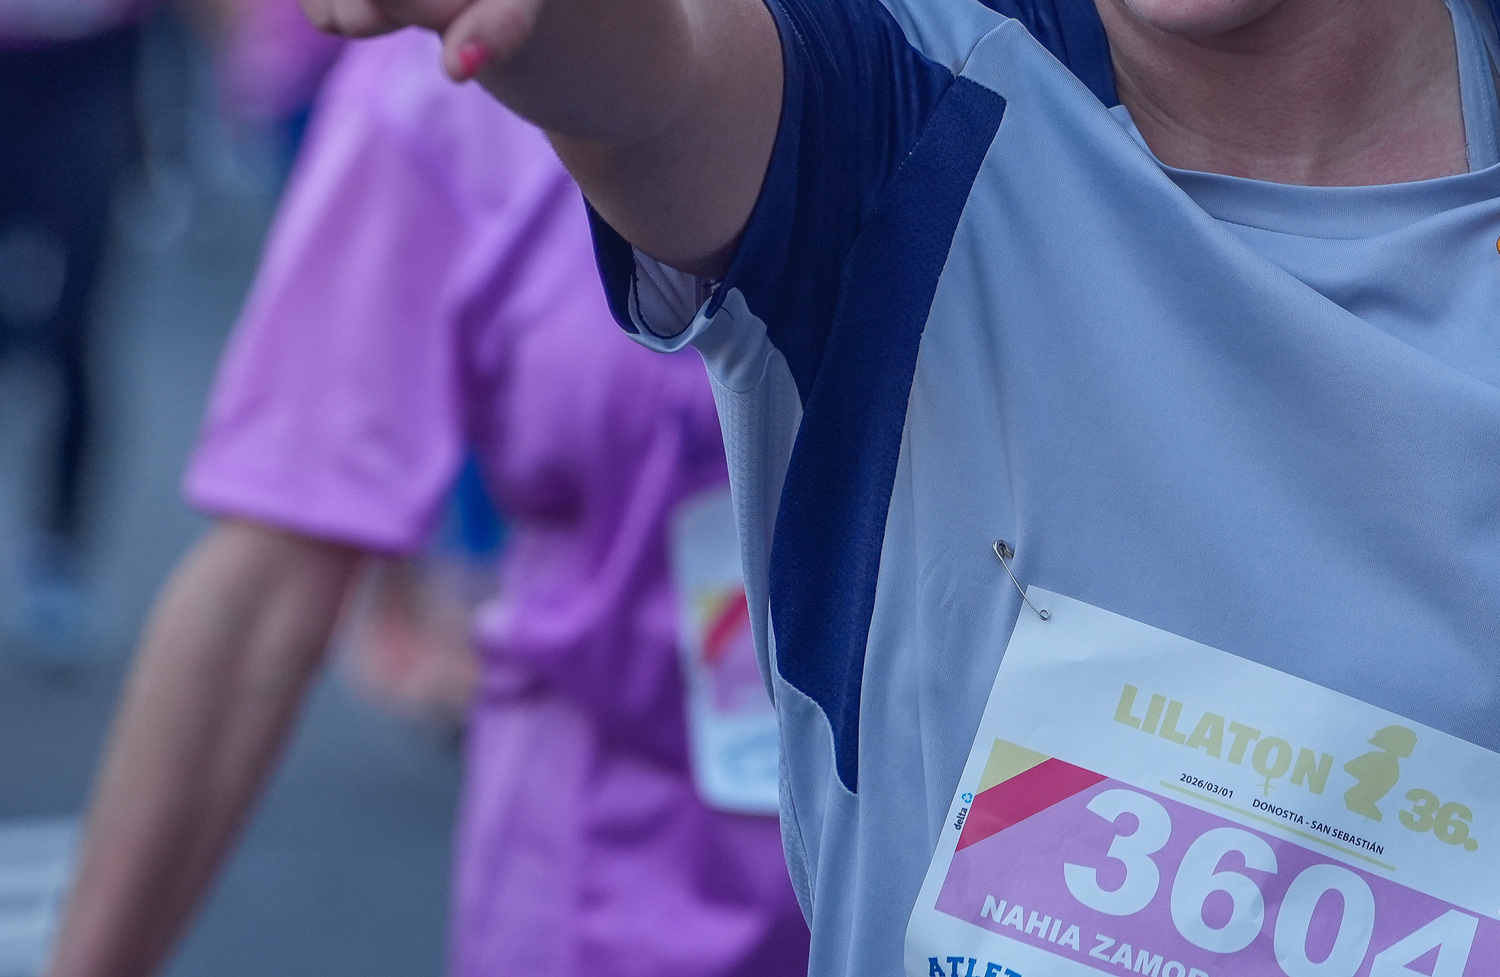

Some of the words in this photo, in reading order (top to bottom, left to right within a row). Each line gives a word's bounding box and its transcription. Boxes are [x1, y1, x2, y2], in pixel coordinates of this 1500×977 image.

[1113, 684, 1334, 796] LILATON
[1180, 773, 1234, 799] 2026/03/01
[954, 807, 968, 831] delta
[1252, 798, 1304, 825] DONOSTIA
[1310, 820, 1331, 835] SAN
[1333, 828, 1384, 855] SEBASTIÁN
[1399, 788, 1479, 852] 36.
[1063, 788, 1480, 977] 3604
[980, 894, 1081, 952] NAHIA
